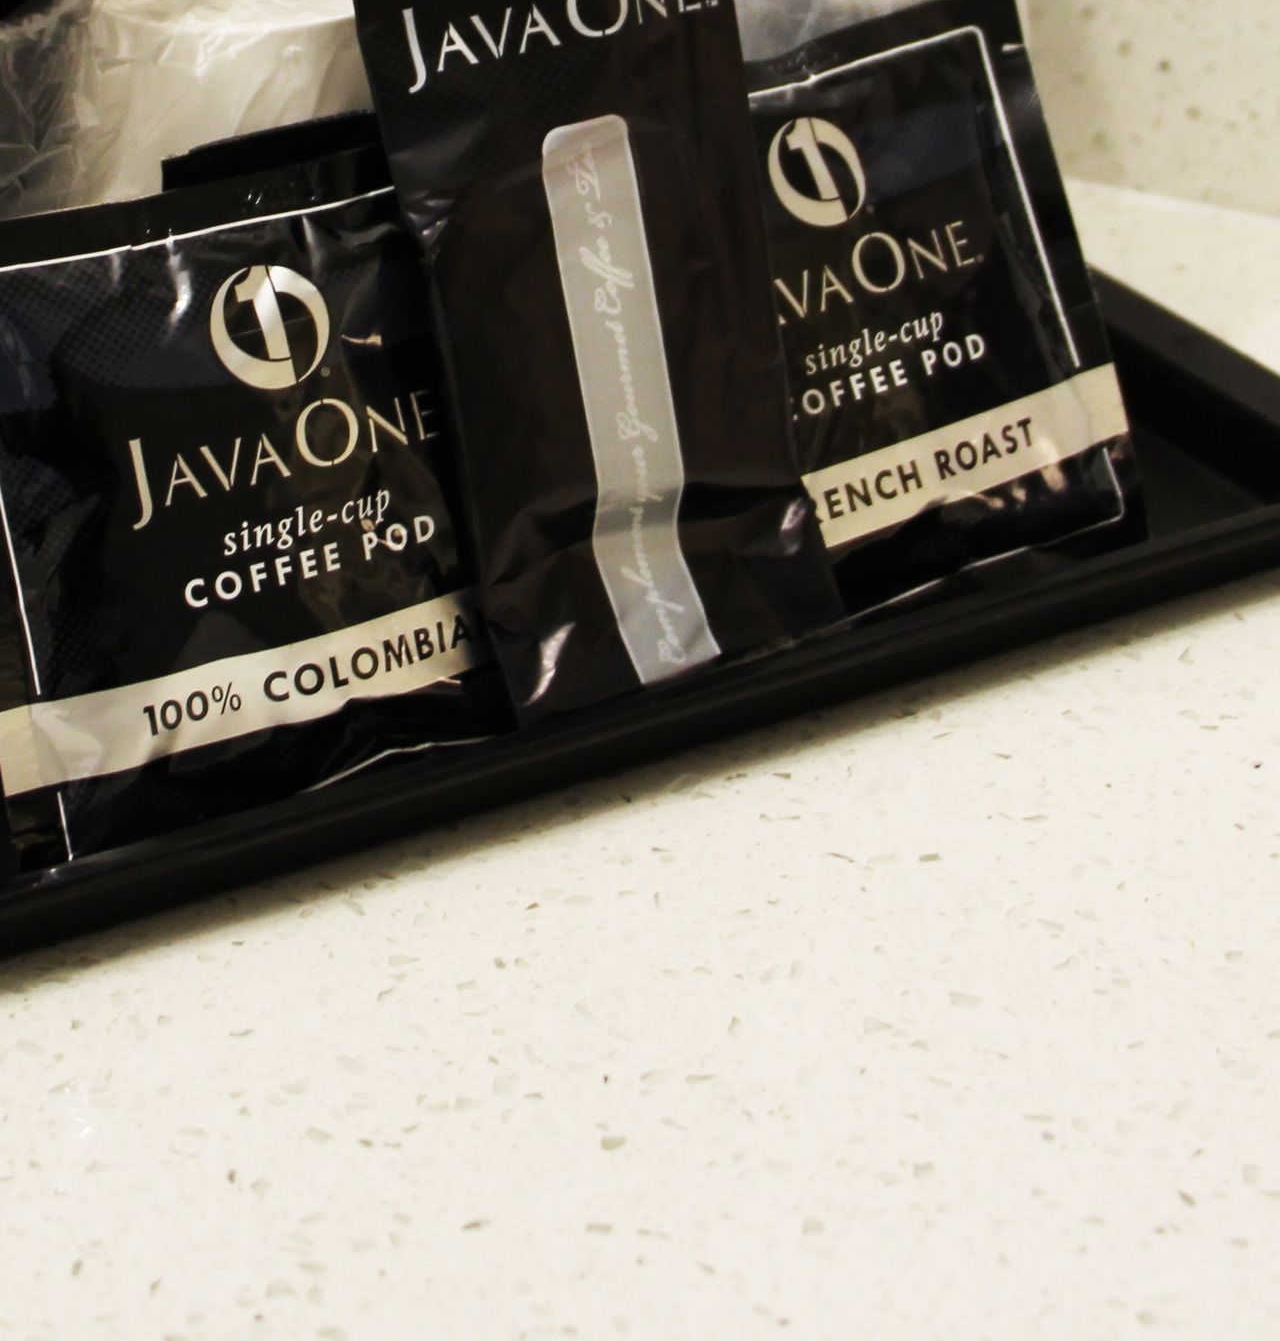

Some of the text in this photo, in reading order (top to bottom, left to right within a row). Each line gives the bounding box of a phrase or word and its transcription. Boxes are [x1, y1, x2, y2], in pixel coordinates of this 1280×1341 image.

[578, 235, 636, 314] Coffee
[774, 220, 976, 325] VAONE
[791, 333, 987, 420] OFFEE POD
[805, 310, 945, 377] single-cup
[817, 418, 1034, 524] ENCH ROAST
[183, 514, 437, 609] COFFEE POD
[222, 488, 392, 558] single-cup
[142, 682, 243, 736] 100%
